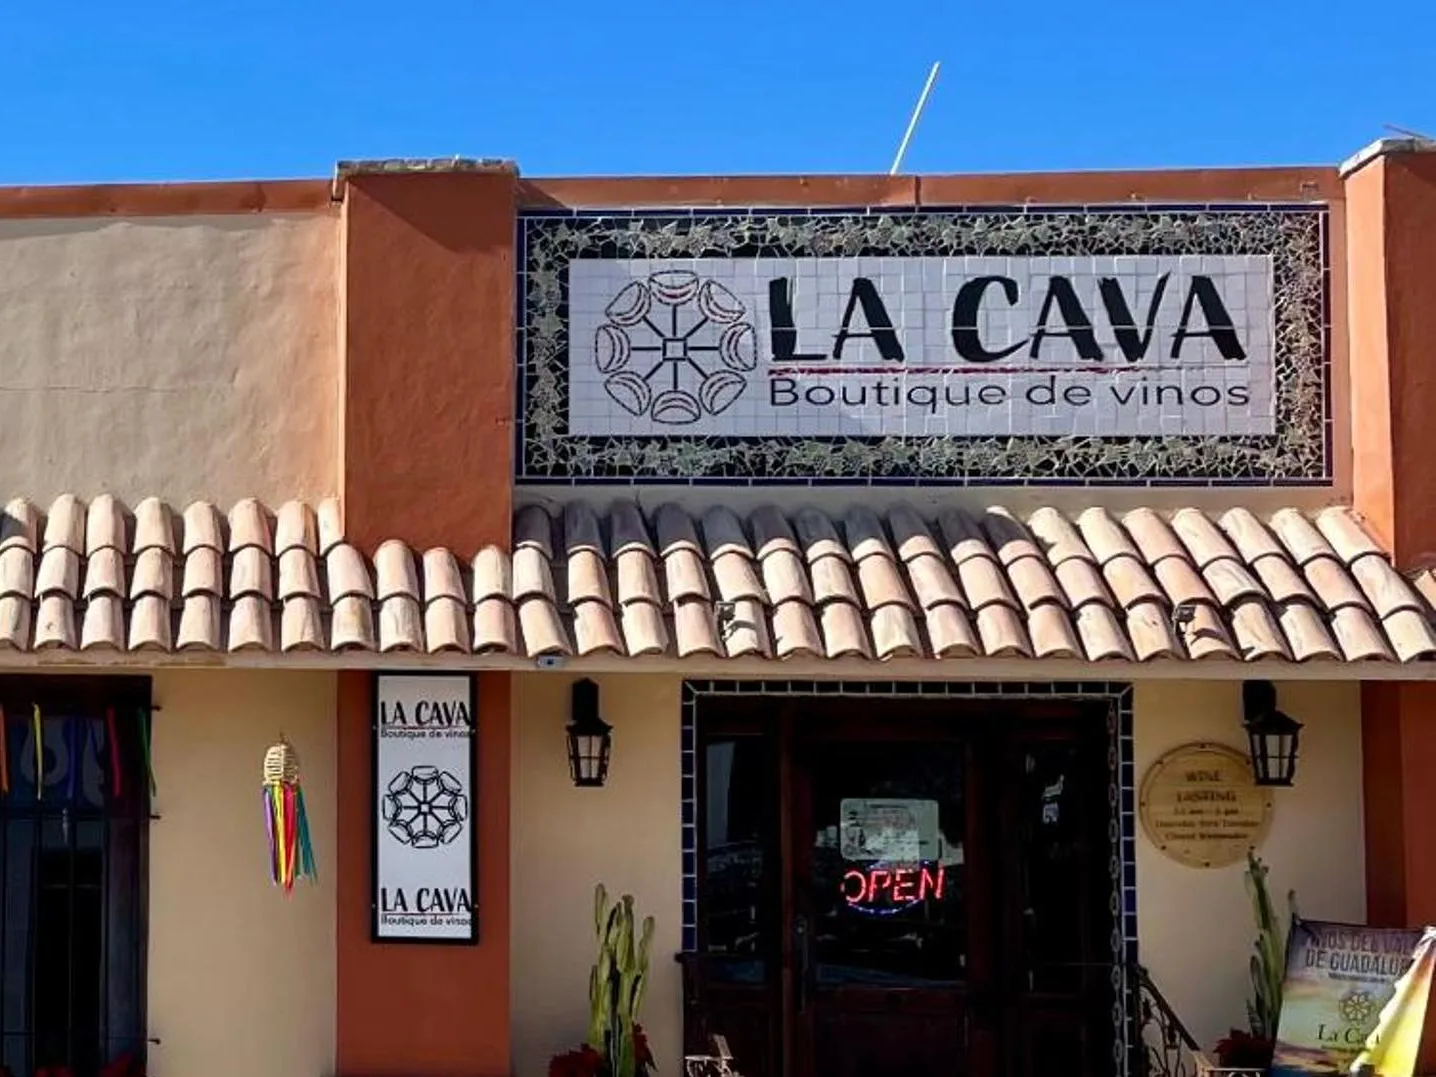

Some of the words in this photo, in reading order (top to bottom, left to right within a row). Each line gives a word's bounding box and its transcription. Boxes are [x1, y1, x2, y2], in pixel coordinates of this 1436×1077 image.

[769, 276, 906, 363] LA
[951, 271, 1247, 363] CAVA
[770, 377, 1007, 414] Boutique
[1025, 375, 1092, 406] de
[1111, 376, 1250, 406] vinos
[380, 700, 407, 726] LA
[415, 700, 473, 727] CAVA
[381, 887, 409, 913] LA
[416, 887, 472, 913] CAVA
[839, 867, 946, 906] OPEN
[1329, 951, 1410, 977] GUADALUP
